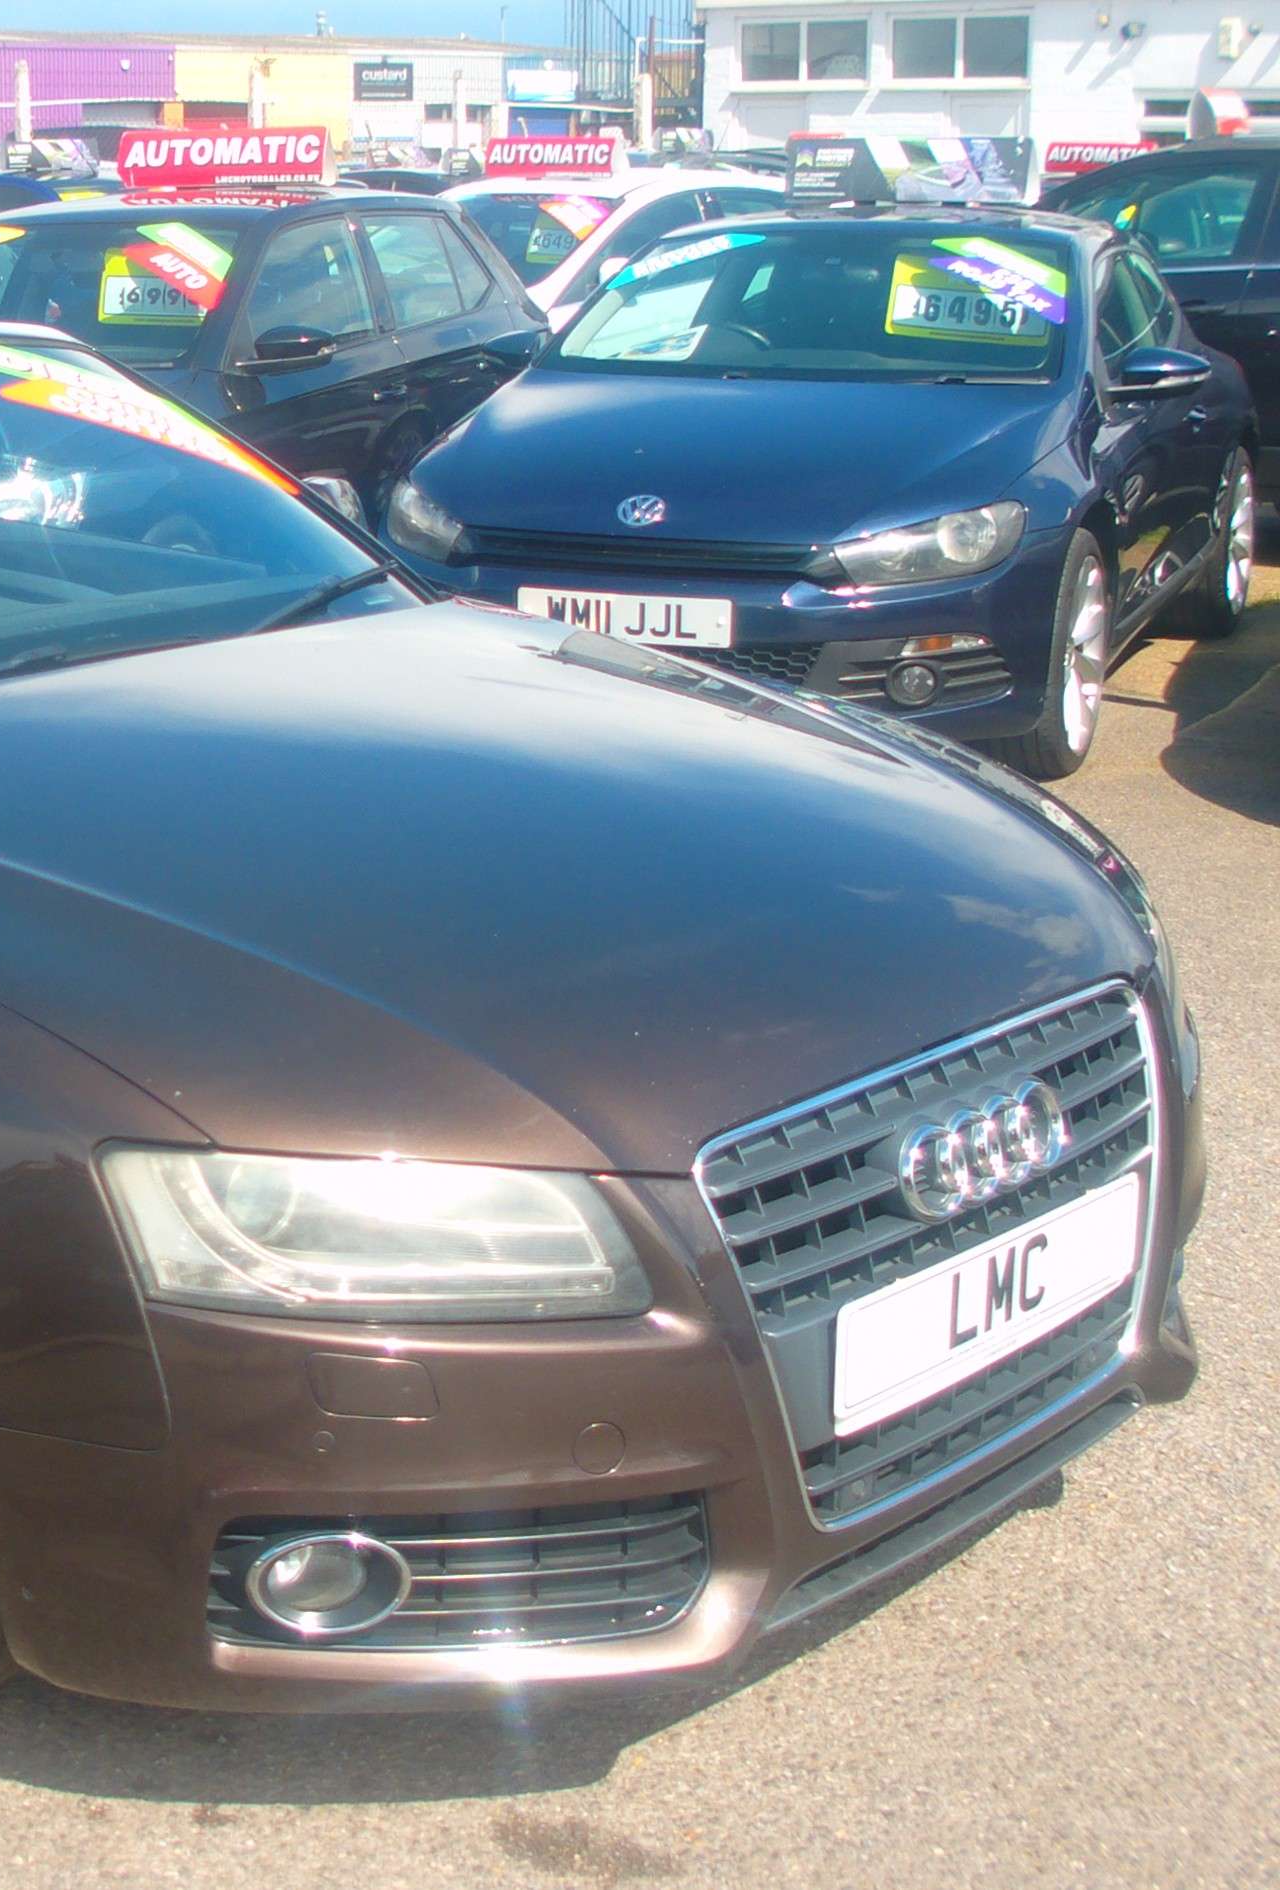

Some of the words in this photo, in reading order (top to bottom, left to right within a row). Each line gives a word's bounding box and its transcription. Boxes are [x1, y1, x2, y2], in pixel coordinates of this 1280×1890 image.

[361, 67, 407, 81] custard
[124, 134, 321, 168] AUTOMATIC
[489, 143, 610, 165] AUTOMATIC
[149, 252, 208, 290] AUTO
[547, 596, 612, 635] WM11
[624, 602, 697, 640] JJL
[949, 1233, 1048, 1350] LMC
